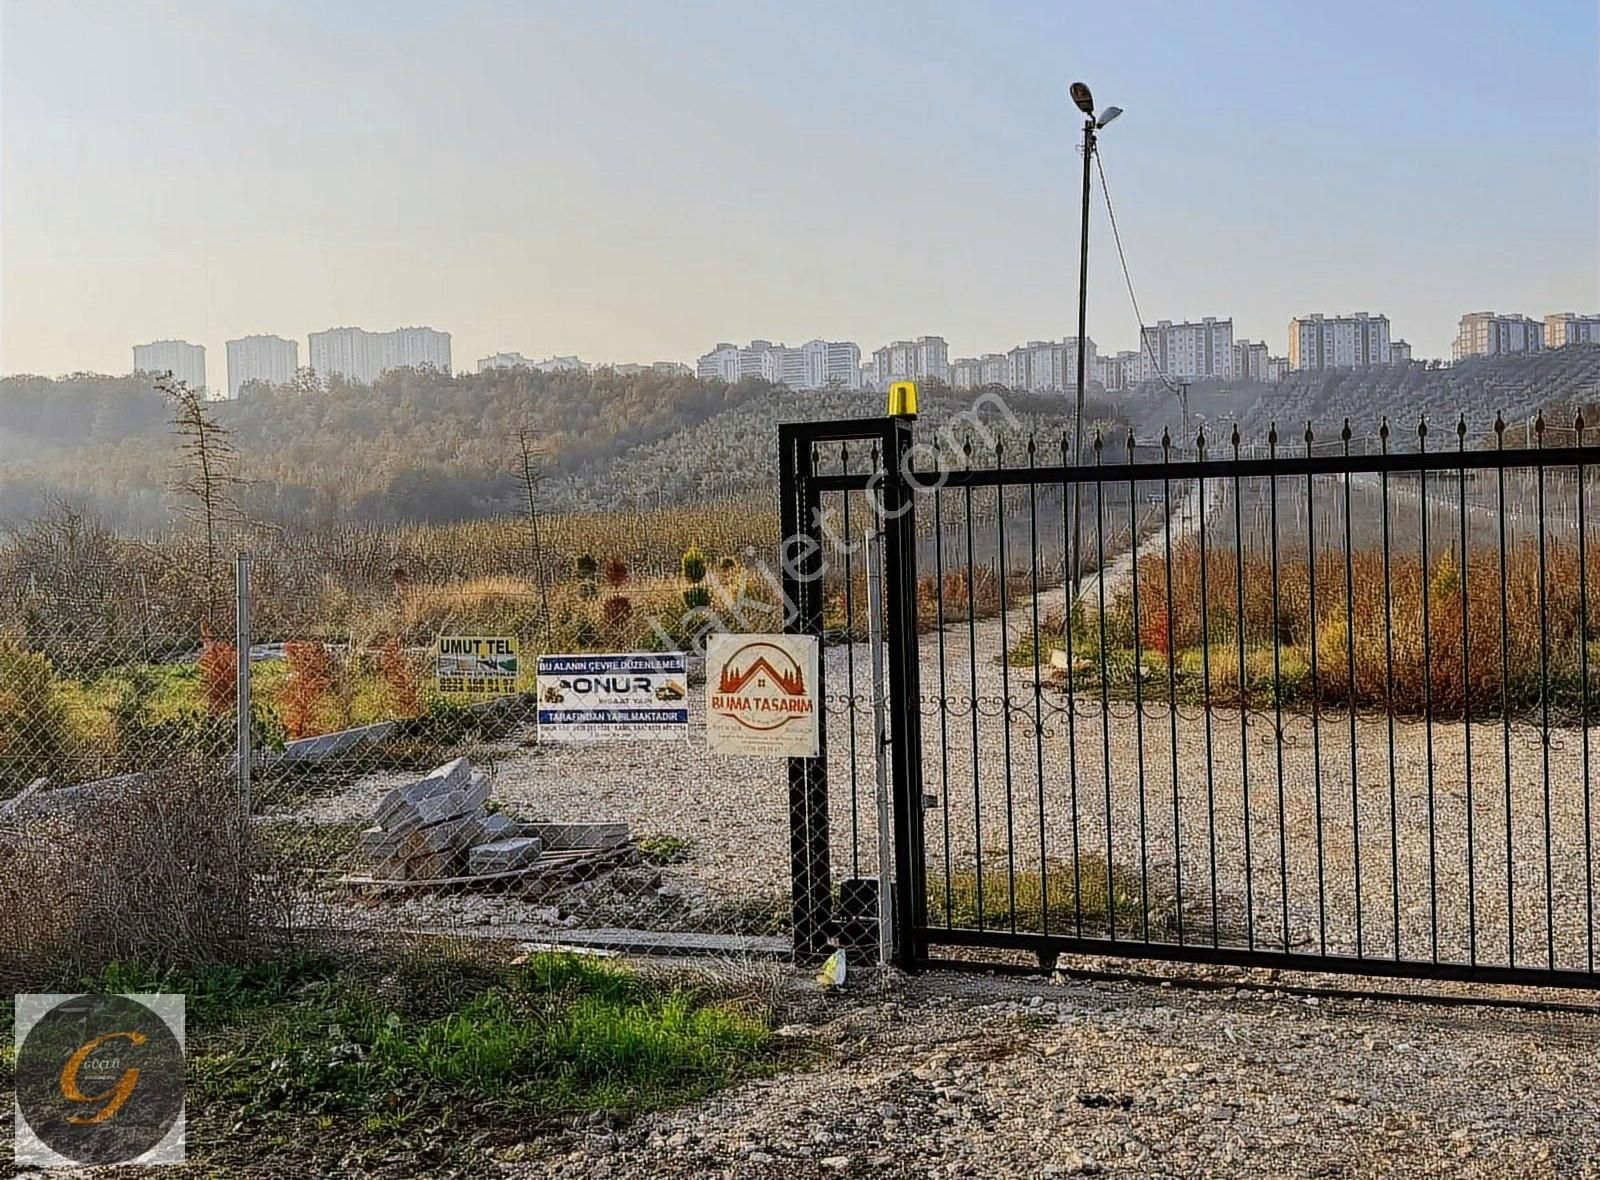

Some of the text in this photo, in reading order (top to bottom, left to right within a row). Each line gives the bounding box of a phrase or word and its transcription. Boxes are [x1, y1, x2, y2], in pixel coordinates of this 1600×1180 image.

[440, 640, 514, 654] UMUT TEL
[573, 677, 652, 694] ONUR
[711, 696, 813, 714] BUMA TASARIM
[549, 710, 678, 722] TARAFINDAN YAPILMAKTADIR
